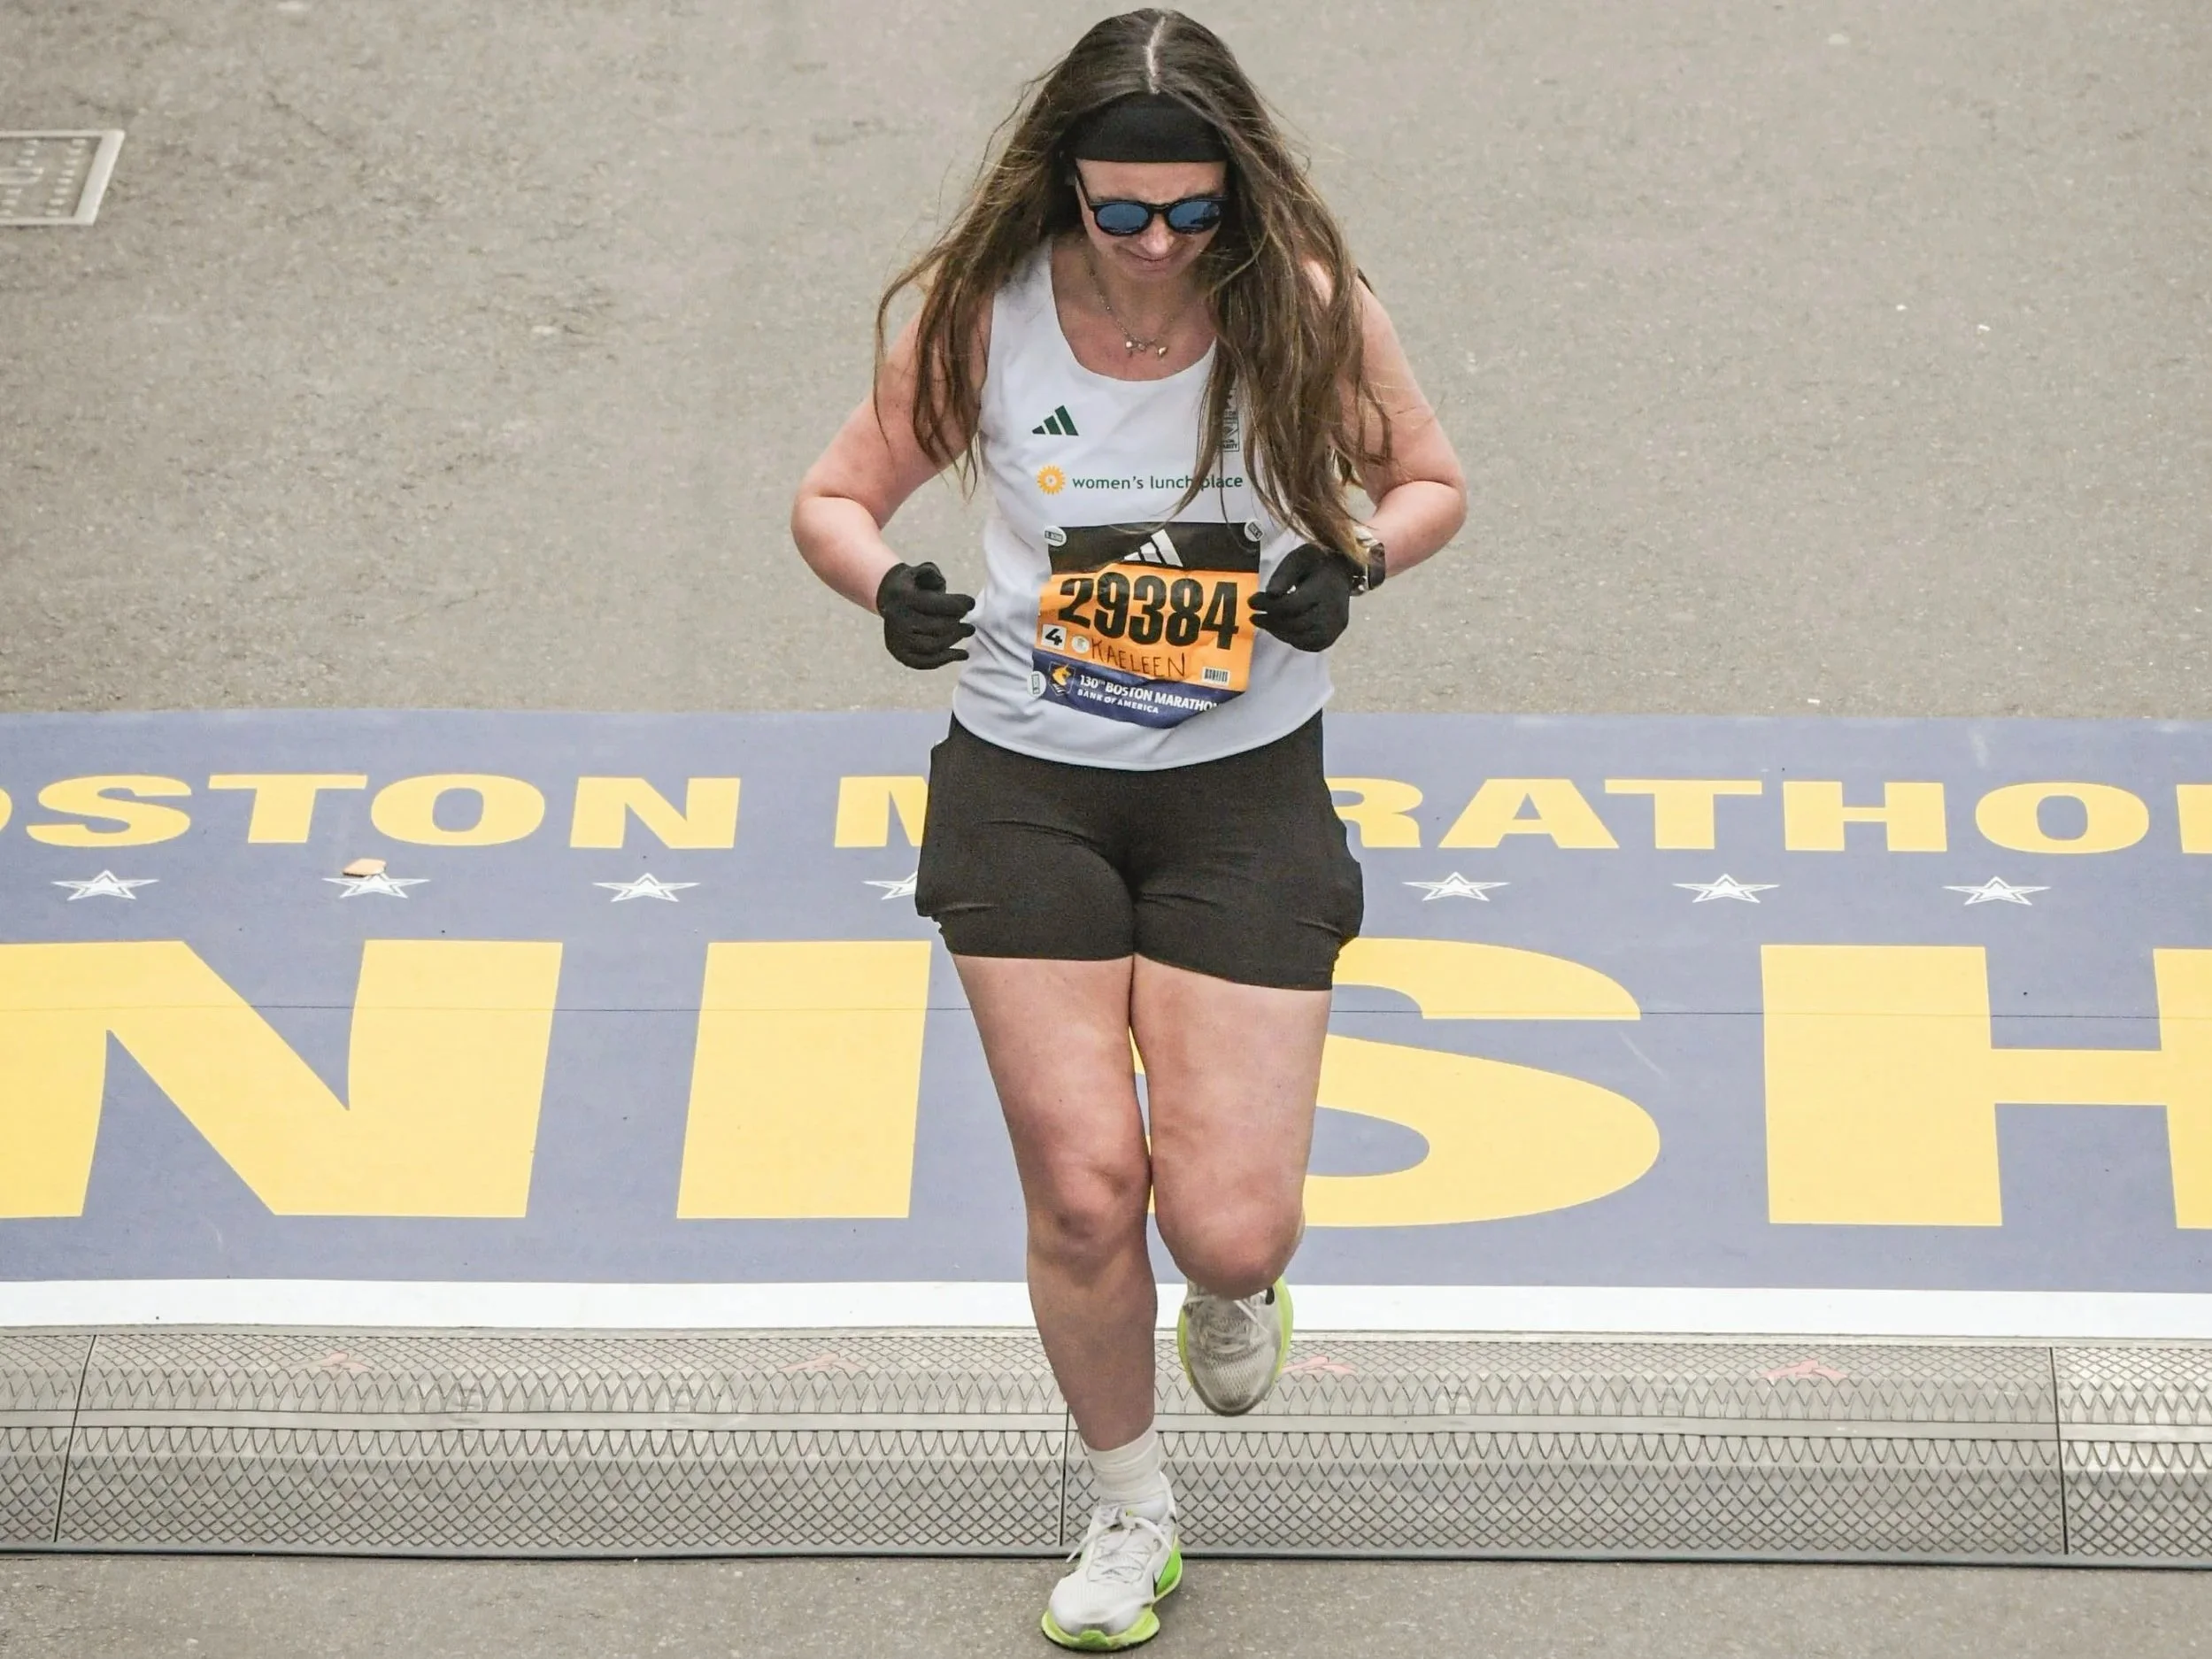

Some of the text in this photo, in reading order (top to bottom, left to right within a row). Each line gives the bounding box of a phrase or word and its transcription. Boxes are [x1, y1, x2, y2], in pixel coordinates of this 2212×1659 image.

[1072, 475, 1244, 491] women's lunch place
[1058, 572, 1238, 650] 29384
[1044, 628, 1063, 645] 4
[1091, 637, 1185, 677] KAELEEN
[1077, 689, 1102, 701] BANK
[1117, 698, 1159, 714] AMERICA
[1105, 679, 1153, 702] BOSTON
[0, 773, 741, 849] STON
